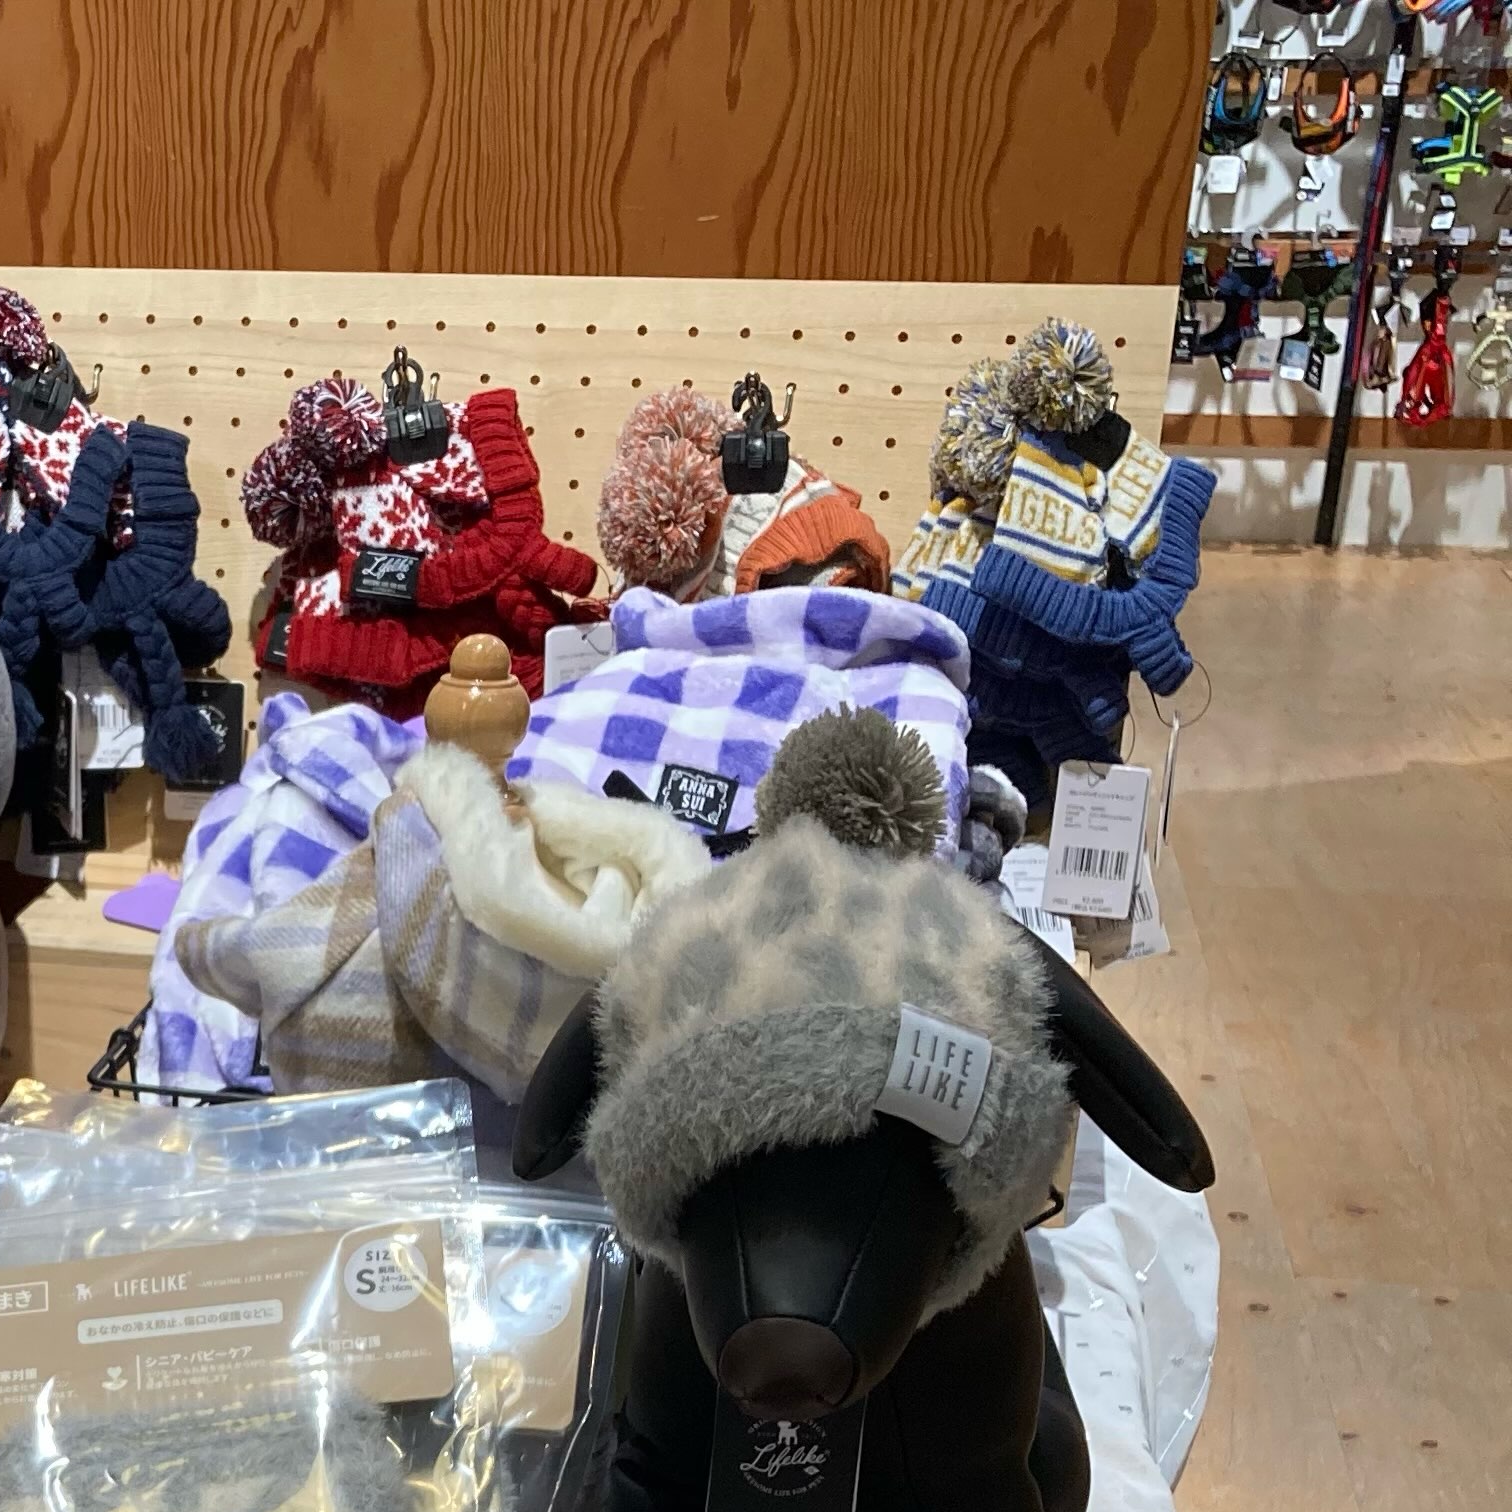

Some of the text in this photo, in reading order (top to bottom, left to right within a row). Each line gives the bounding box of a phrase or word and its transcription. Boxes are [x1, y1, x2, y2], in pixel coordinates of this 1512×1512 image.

[678, 777, 716, 799] ANNA
[681, 793, 706, 811] SUI
[912, 1029, 974, 1078] LIFE
[903, 1060, 968, 1110] LIKE
[114, 1273, 188, 1298] LIFELIKE
[356, 1268, 376, 1294] S
[740, 1443, 827, 1477] Lifelike
